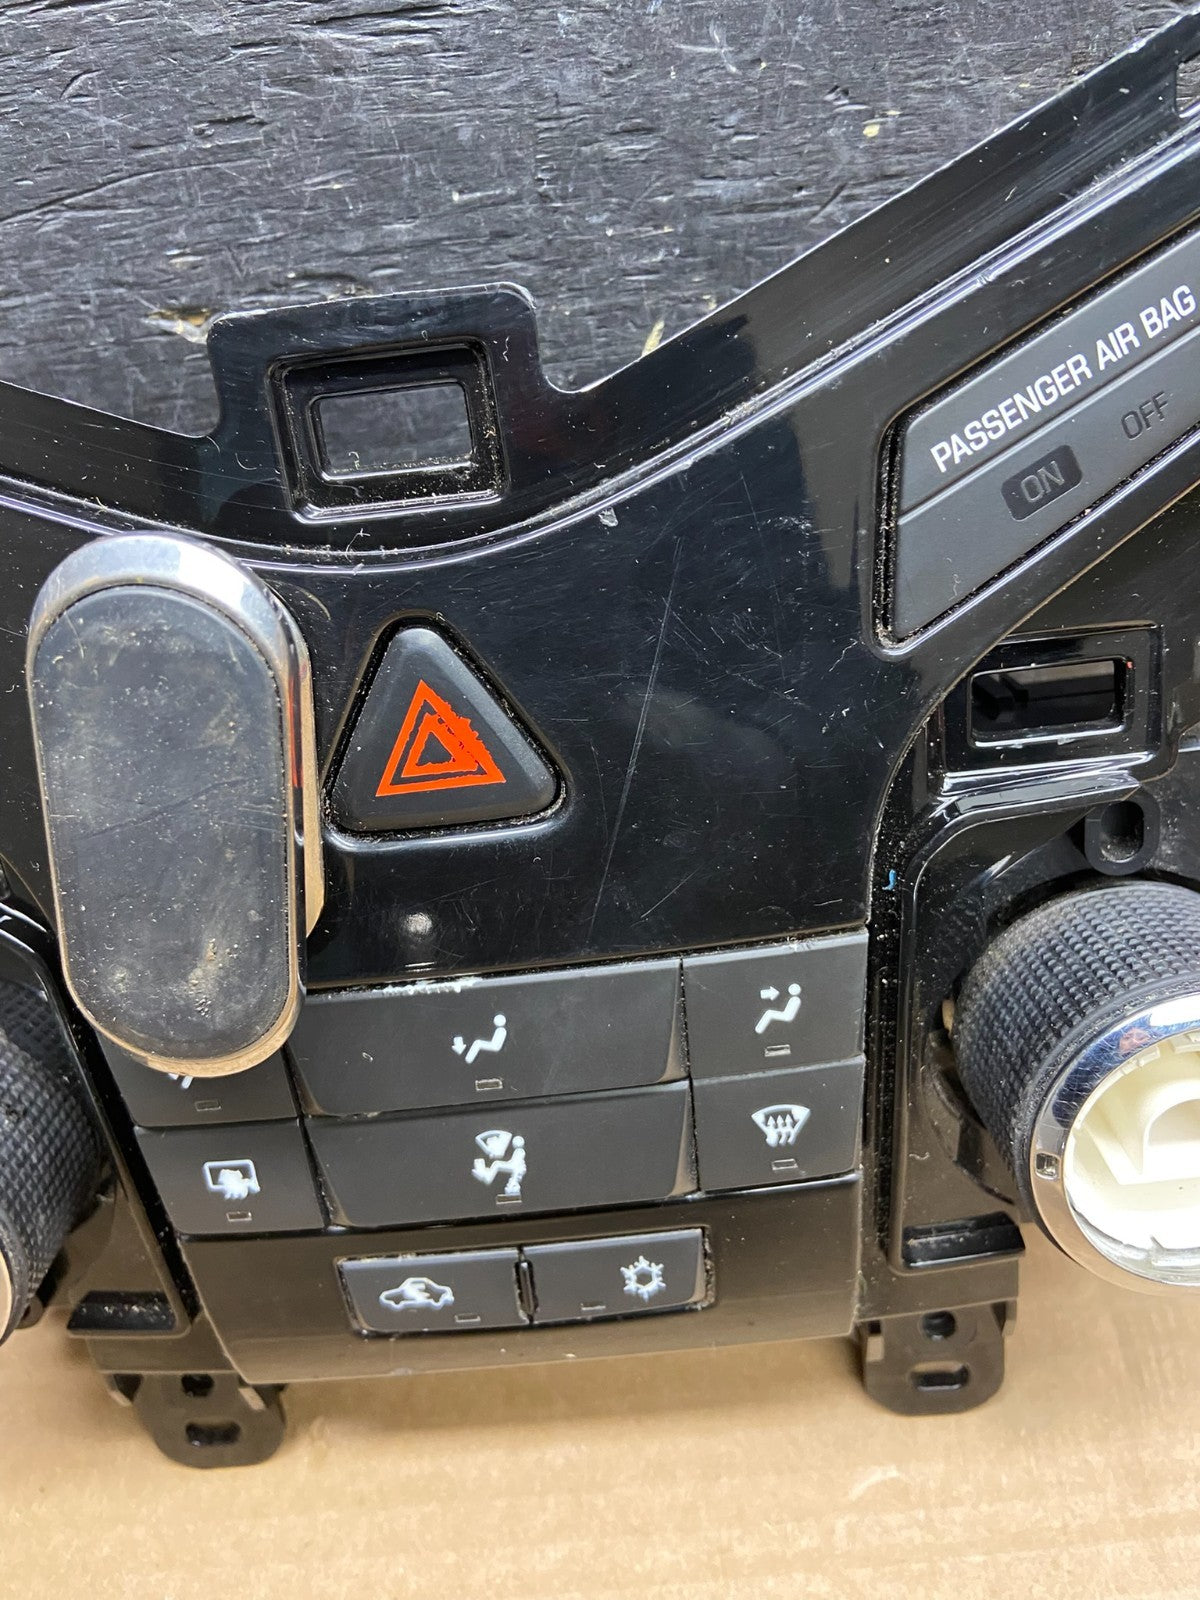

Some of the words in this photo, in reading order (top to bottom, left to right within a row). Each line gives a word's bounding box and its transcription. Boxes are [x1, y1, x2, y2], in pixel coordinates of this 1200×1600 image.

[930, 353, 1093, 473] PASSENGER
[1095, 322, 1141, 371] AIR
[1139, 284, 1197, 339] BAG
[1020, 459, 1066, 504] ON
[1120, 391, 1170, 441] OFF
